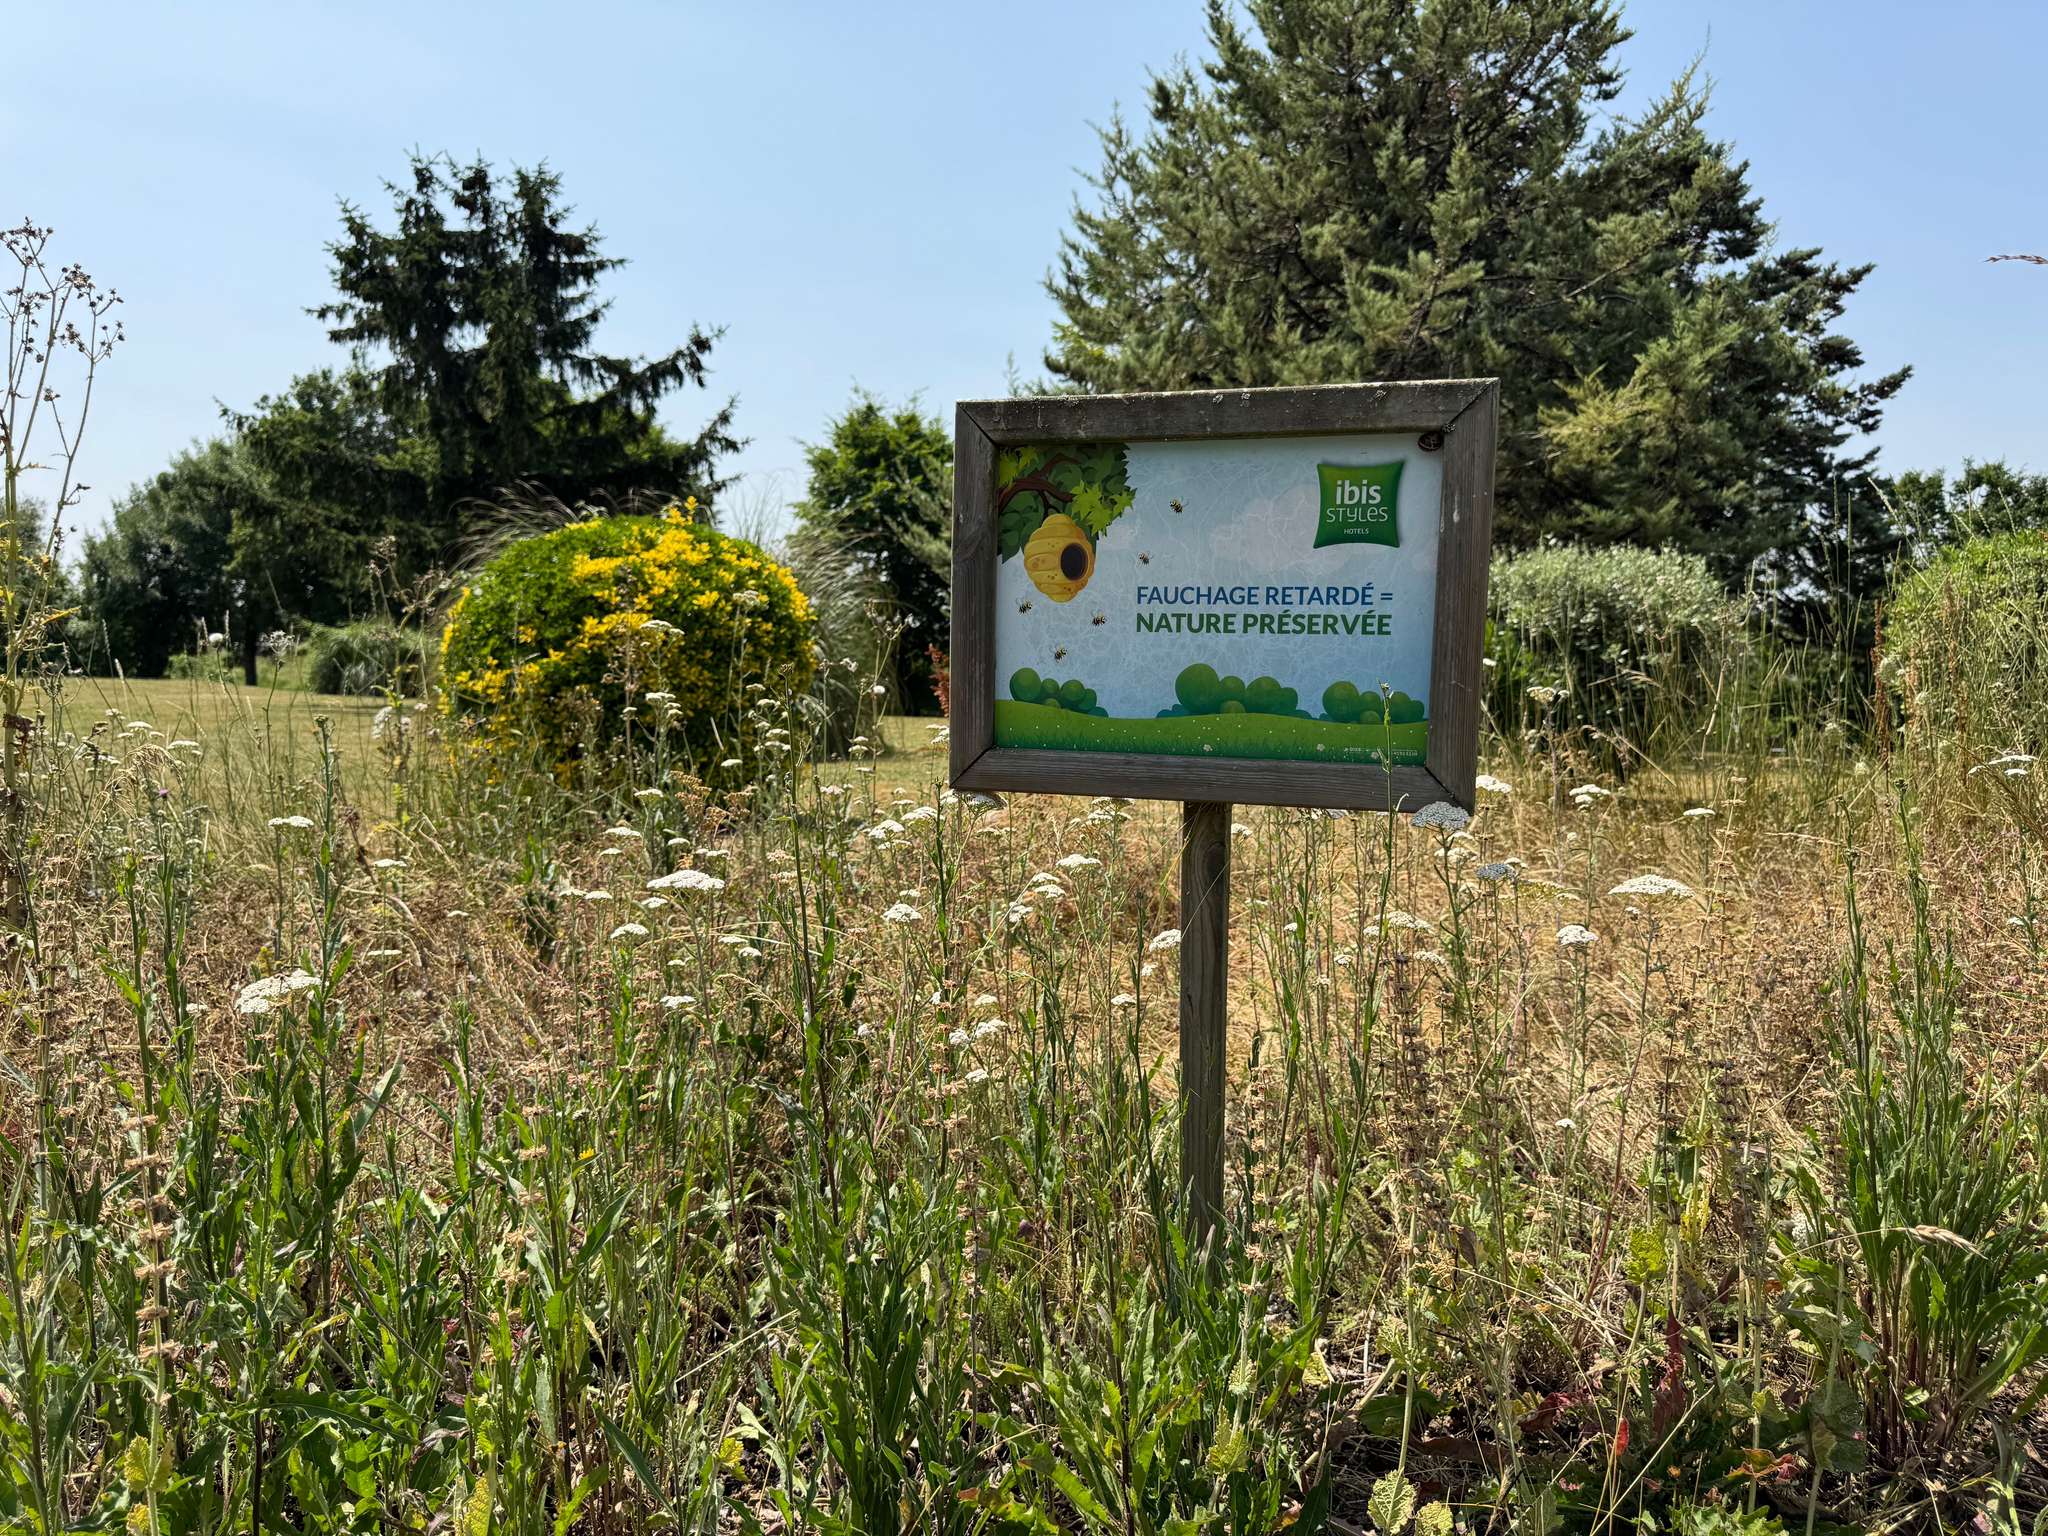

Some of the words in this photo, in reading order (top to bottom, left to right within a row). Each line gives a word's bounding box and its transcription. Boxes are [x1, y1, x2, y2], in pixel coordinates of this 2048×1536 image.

[1336, 480, 1381, 504] ibis
[1137, 586, 1259, 605] FAUCHAGE
[1265, 582, 1374, 606] RETARDÉ
[1136, 612, 1237, 635] NATURE
[1242, 609, 1393, 636] PRÉSERVÉE
